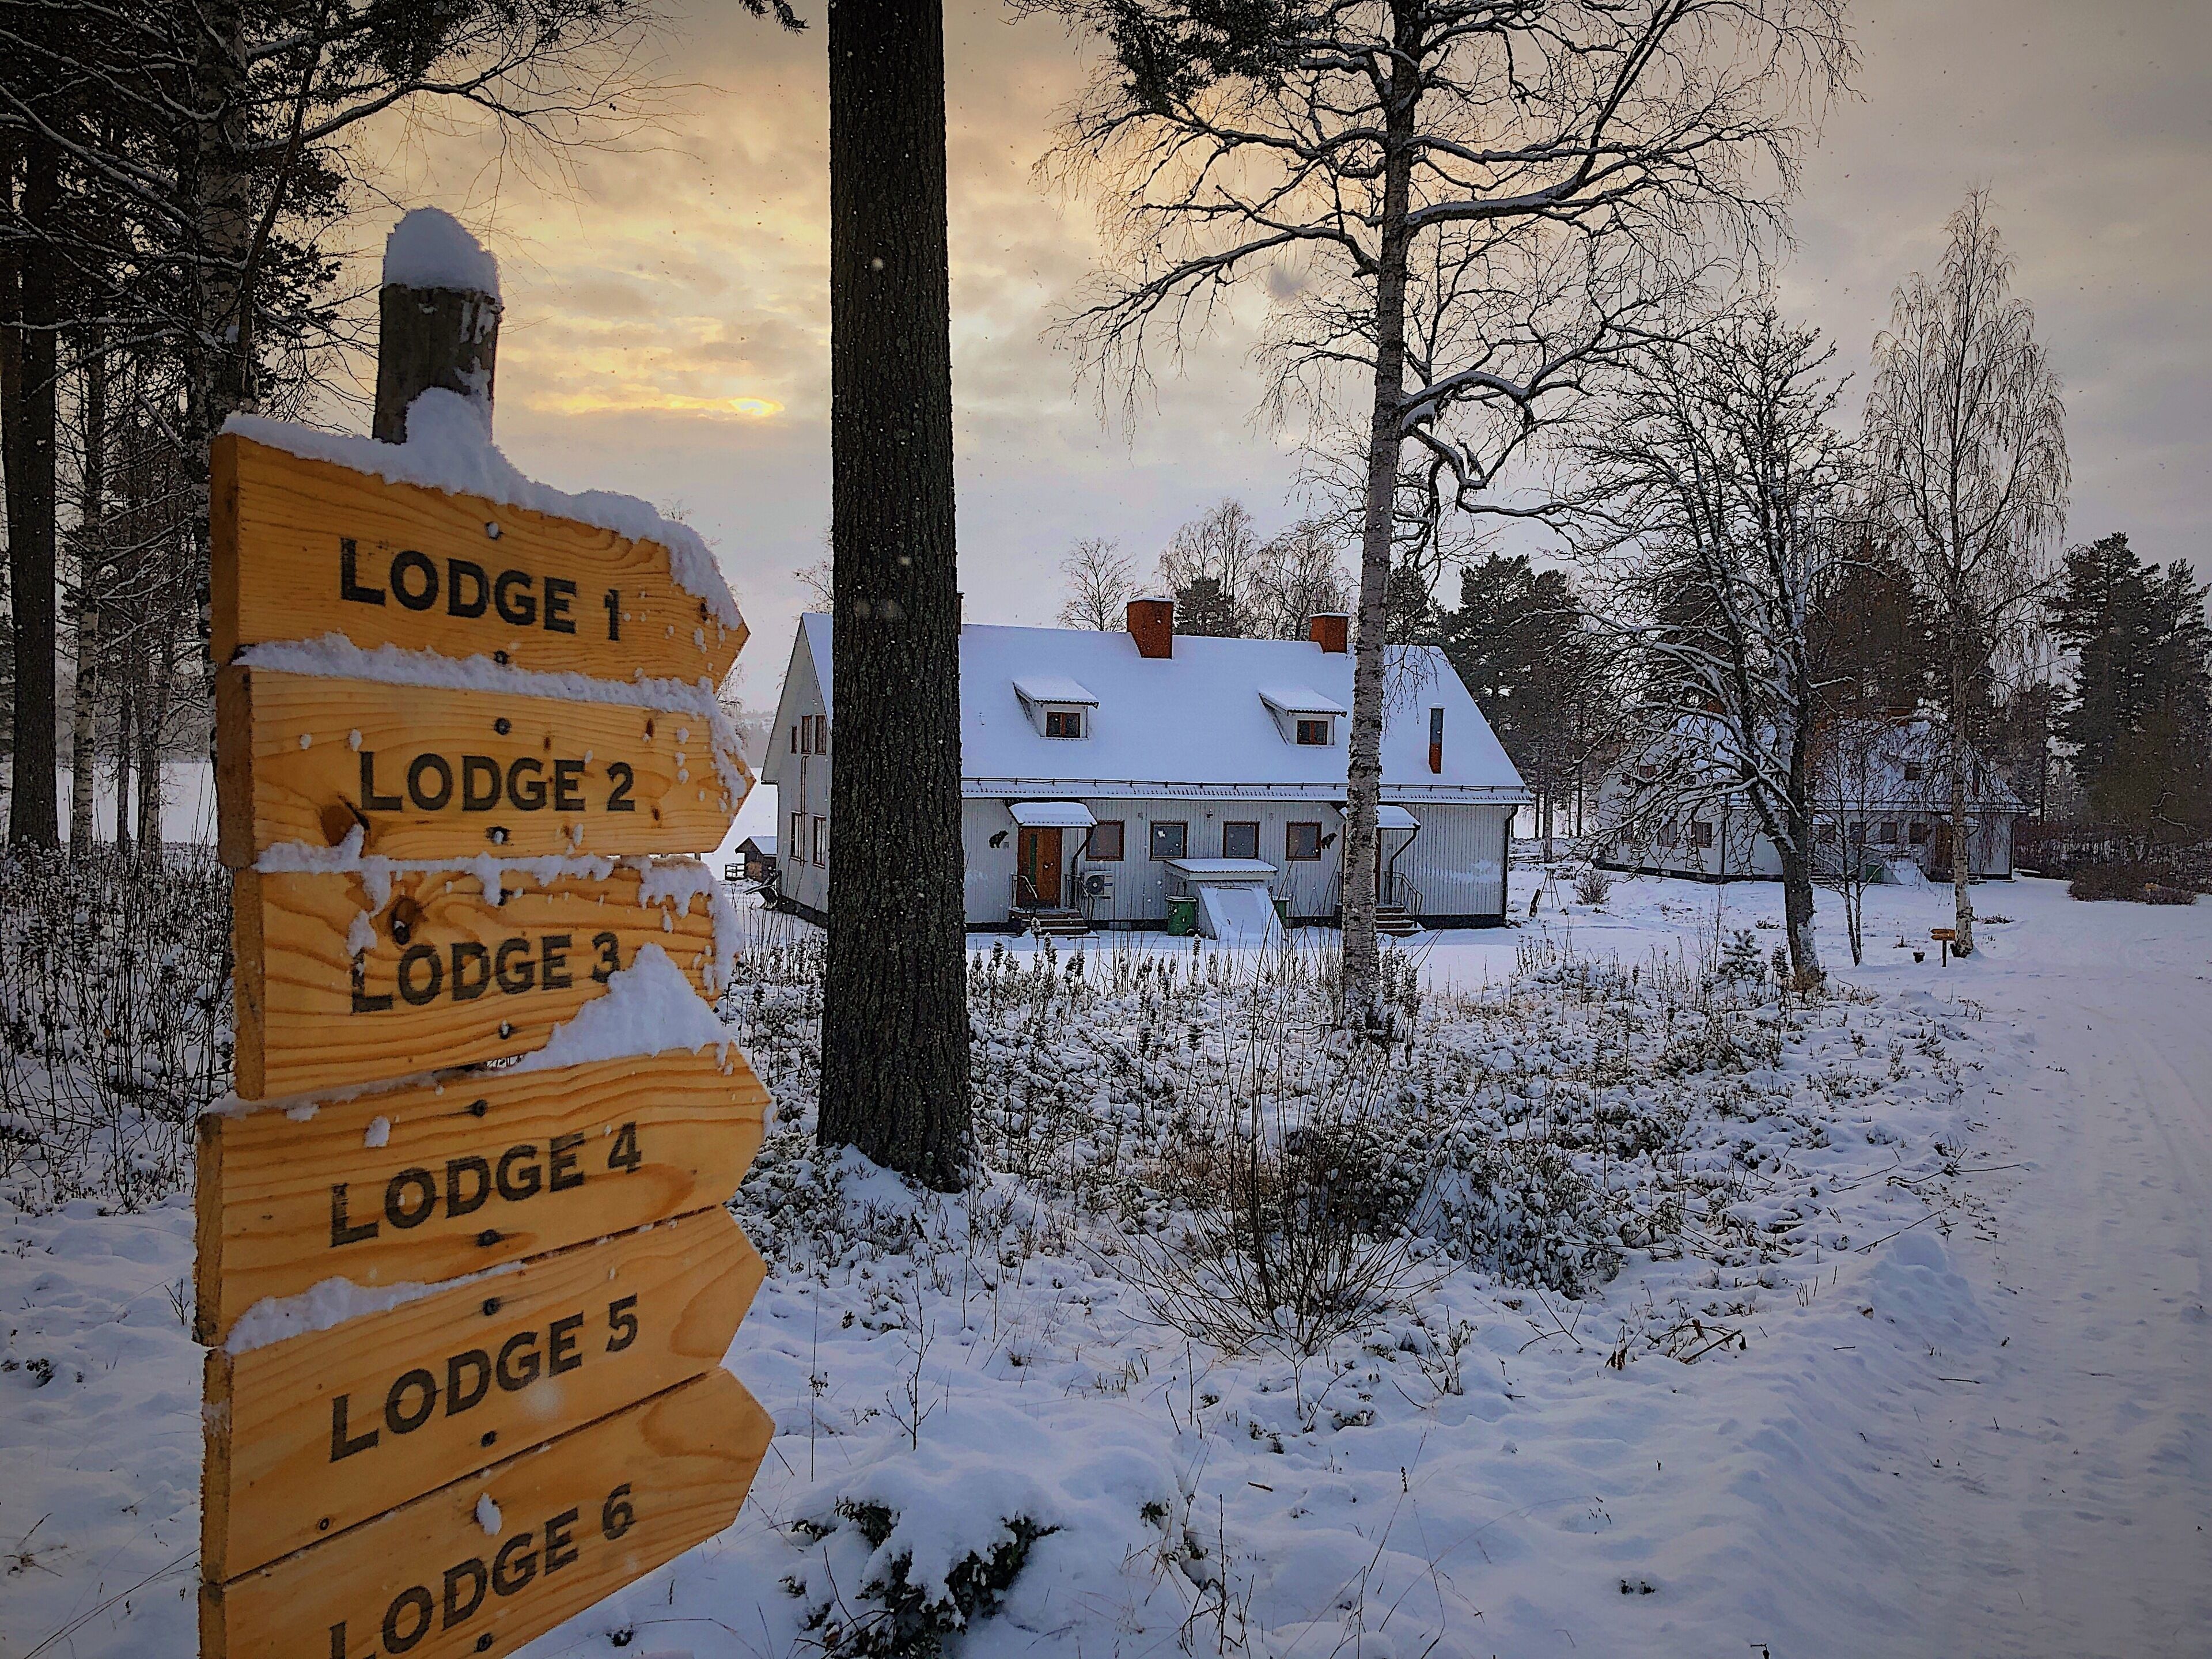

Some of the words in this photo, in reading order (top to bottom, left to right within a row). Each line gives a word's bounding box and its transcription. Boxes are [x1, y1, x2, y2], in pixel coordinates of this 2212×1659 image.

[340, 538, 577, 634] LODGE
[604, 588, 620, 641] 1
[359, 751, 586, 812] LODGE
[606, 762, 635, 812] 2
[351, 934, 573, 1014] LODGE
[591, 931, 620, 983] 3
[329, 1132, 586, 1248] LODGE
[607, 1122, 642, 1174] 4
[328, 1311, 584, 1463] LODGE
[605, 1293, 638, 1353] 5
[601, 1483, 637, 1541] 6
